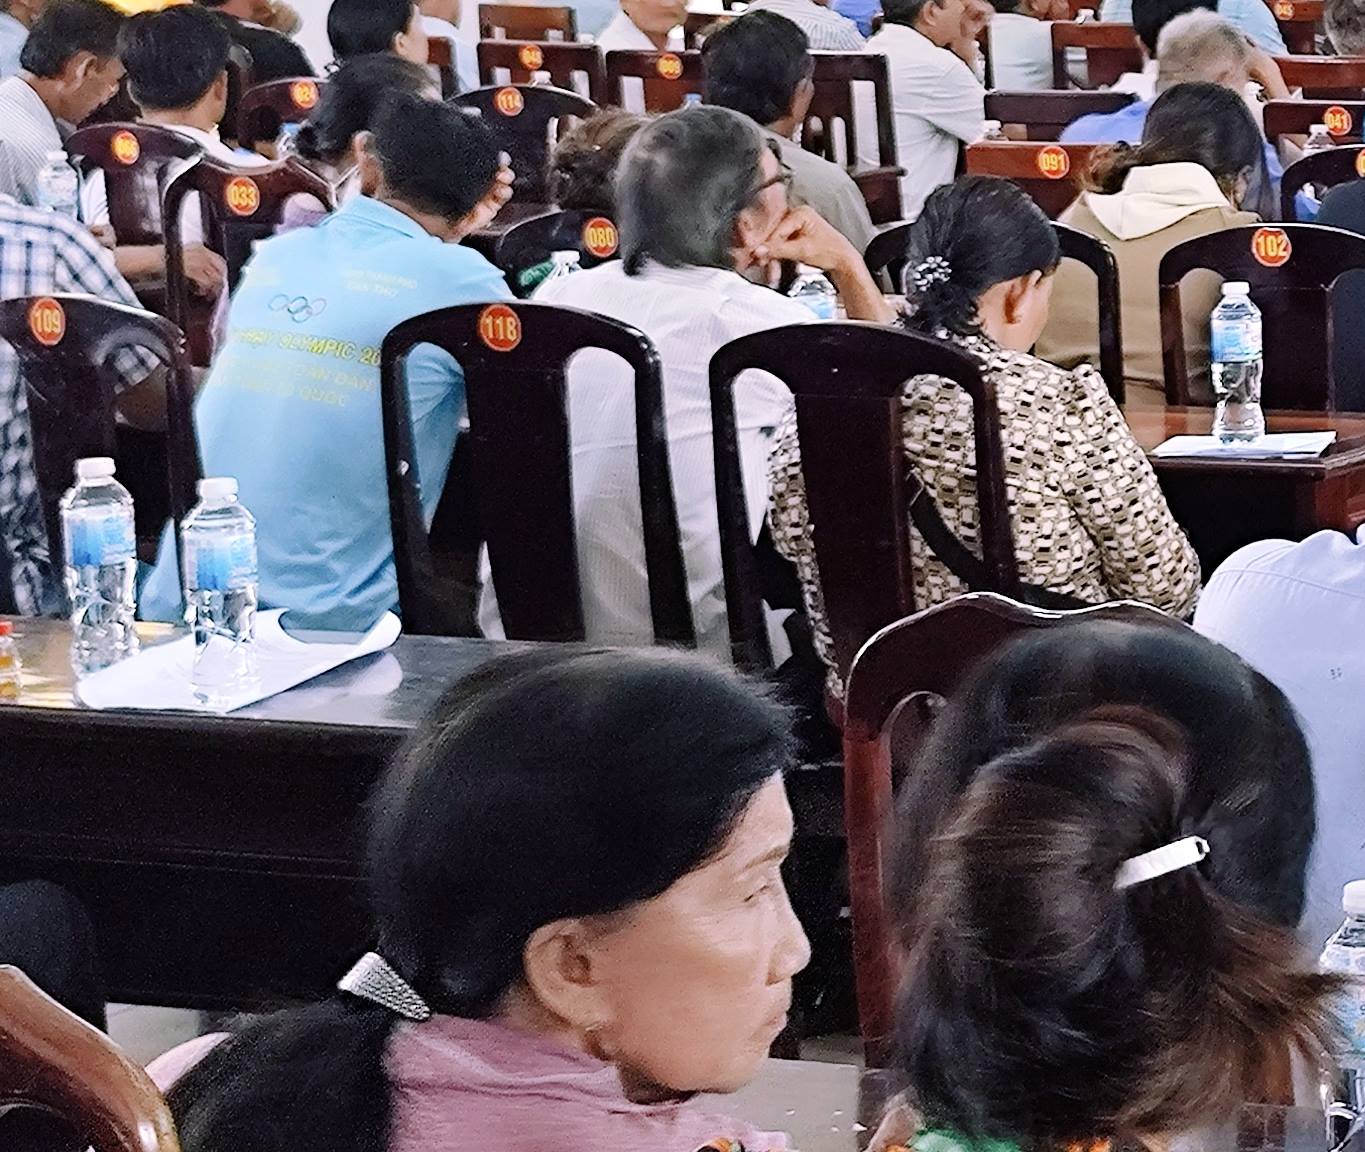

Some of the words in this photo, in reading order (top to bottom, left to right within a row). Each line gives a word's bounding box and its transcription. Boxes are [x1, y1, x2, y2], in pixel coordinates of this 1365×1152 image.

[1040, 153, 1068, 173] 091
[227, 186, 257, 209] 033
[1257, 233, 1288, 259] 102
[32, 308, 62, 336] 109
[484, 314, 517, 342] 118
